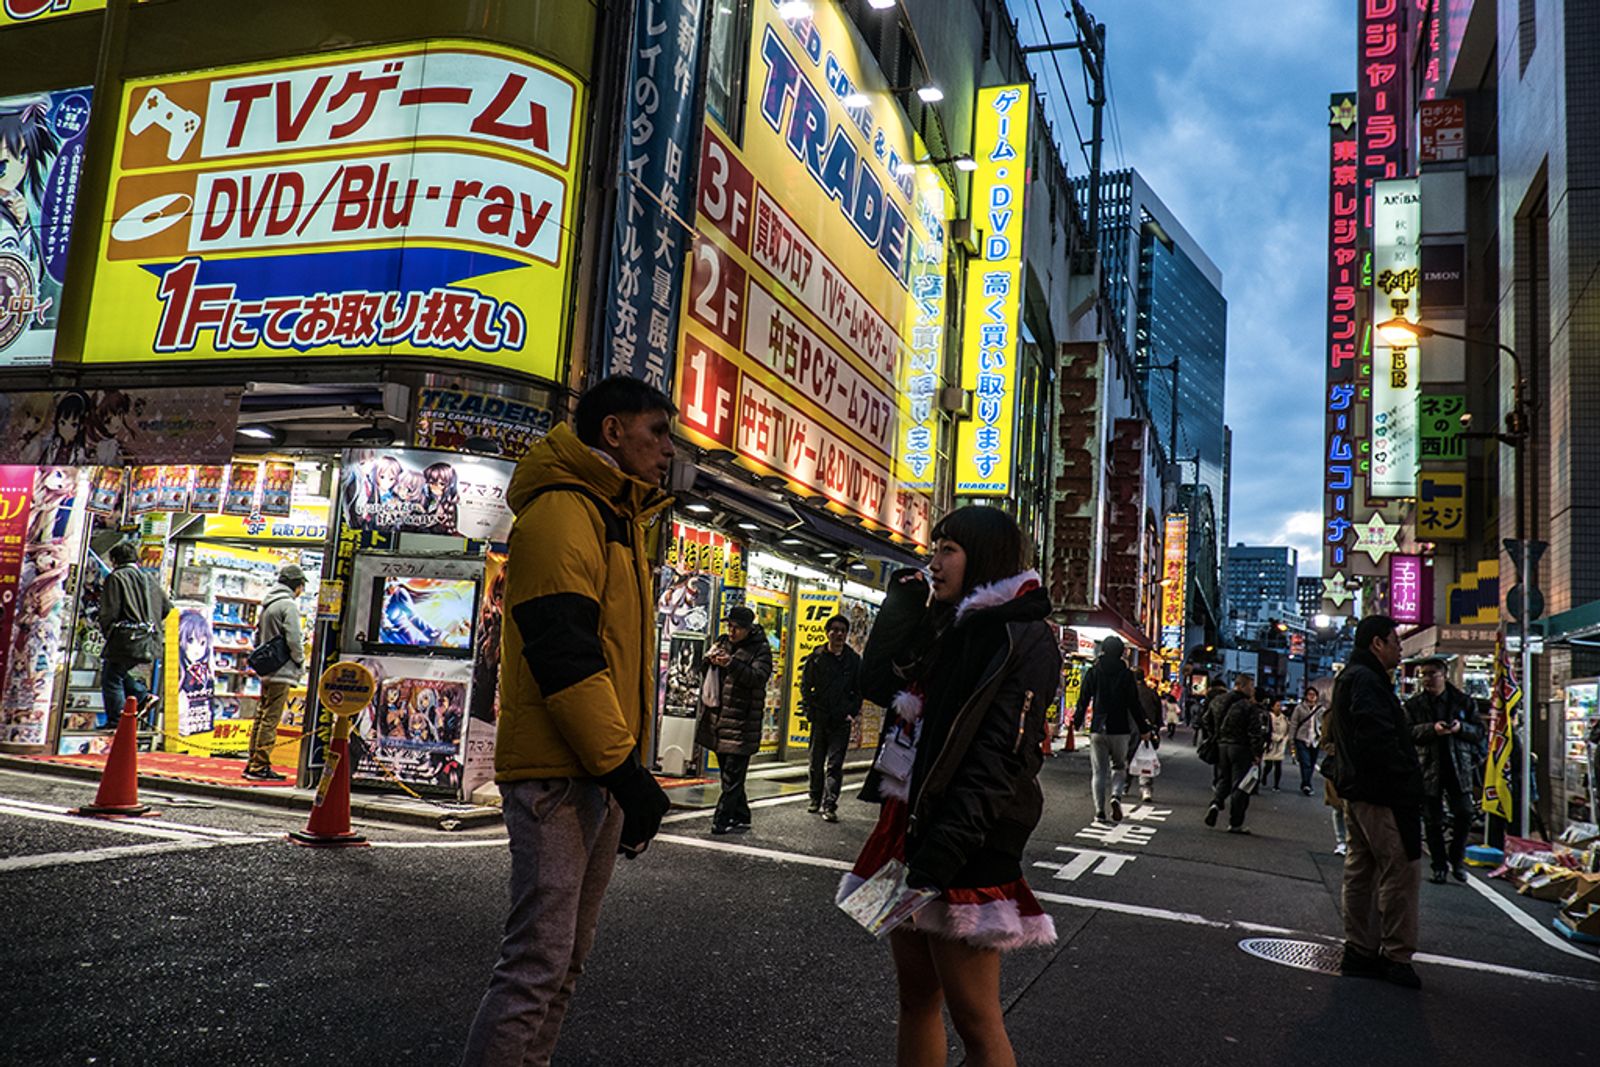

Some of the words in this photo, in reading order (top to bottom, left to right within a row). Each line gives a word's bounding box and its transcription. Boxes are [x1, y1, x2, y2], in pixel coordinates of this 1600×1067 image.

[224, 62, 551, 153] TVゲーム
[1422, 105, 1462, 117] ロボット
[1422, 115, 1463, 127] センター
[761, 22, 911, 292] TRADE
[987, 91, 1019, 259] ゲーム・DVD
[703, 142, 747, 238] 3F
[756, 198, 813, 293] 買取フロア
[1331, 141, 1358, 368] 東京レジャーランド
[1424, 271, 1461, 280] IMON
[154, 256, 526, 351] 1Fにてお取り扱い
[694, 244, 739, 335] 2F
[768, 308, 890, 443] 中古PCゲームフロア
[976, 273, 1009, 478] 高く買い取ります
[686, 350, 731, 434] 1F
[740, 388, 887, 514] 中古TVゲーム&DVDフロア
[1421, 397, 1463, 417] ネジ
[1433, 417, 1451, 433] の
[1421, 434, 1463, 457] 西川
[1328, 385, 1355, 564] ゲームコーナー
[247, 523, 266, 536] 3F
[1421, 507, 1462, 530] ネジ
[806, 605, 832, 621] 1F
[807, 634, 825, 642] DVD
